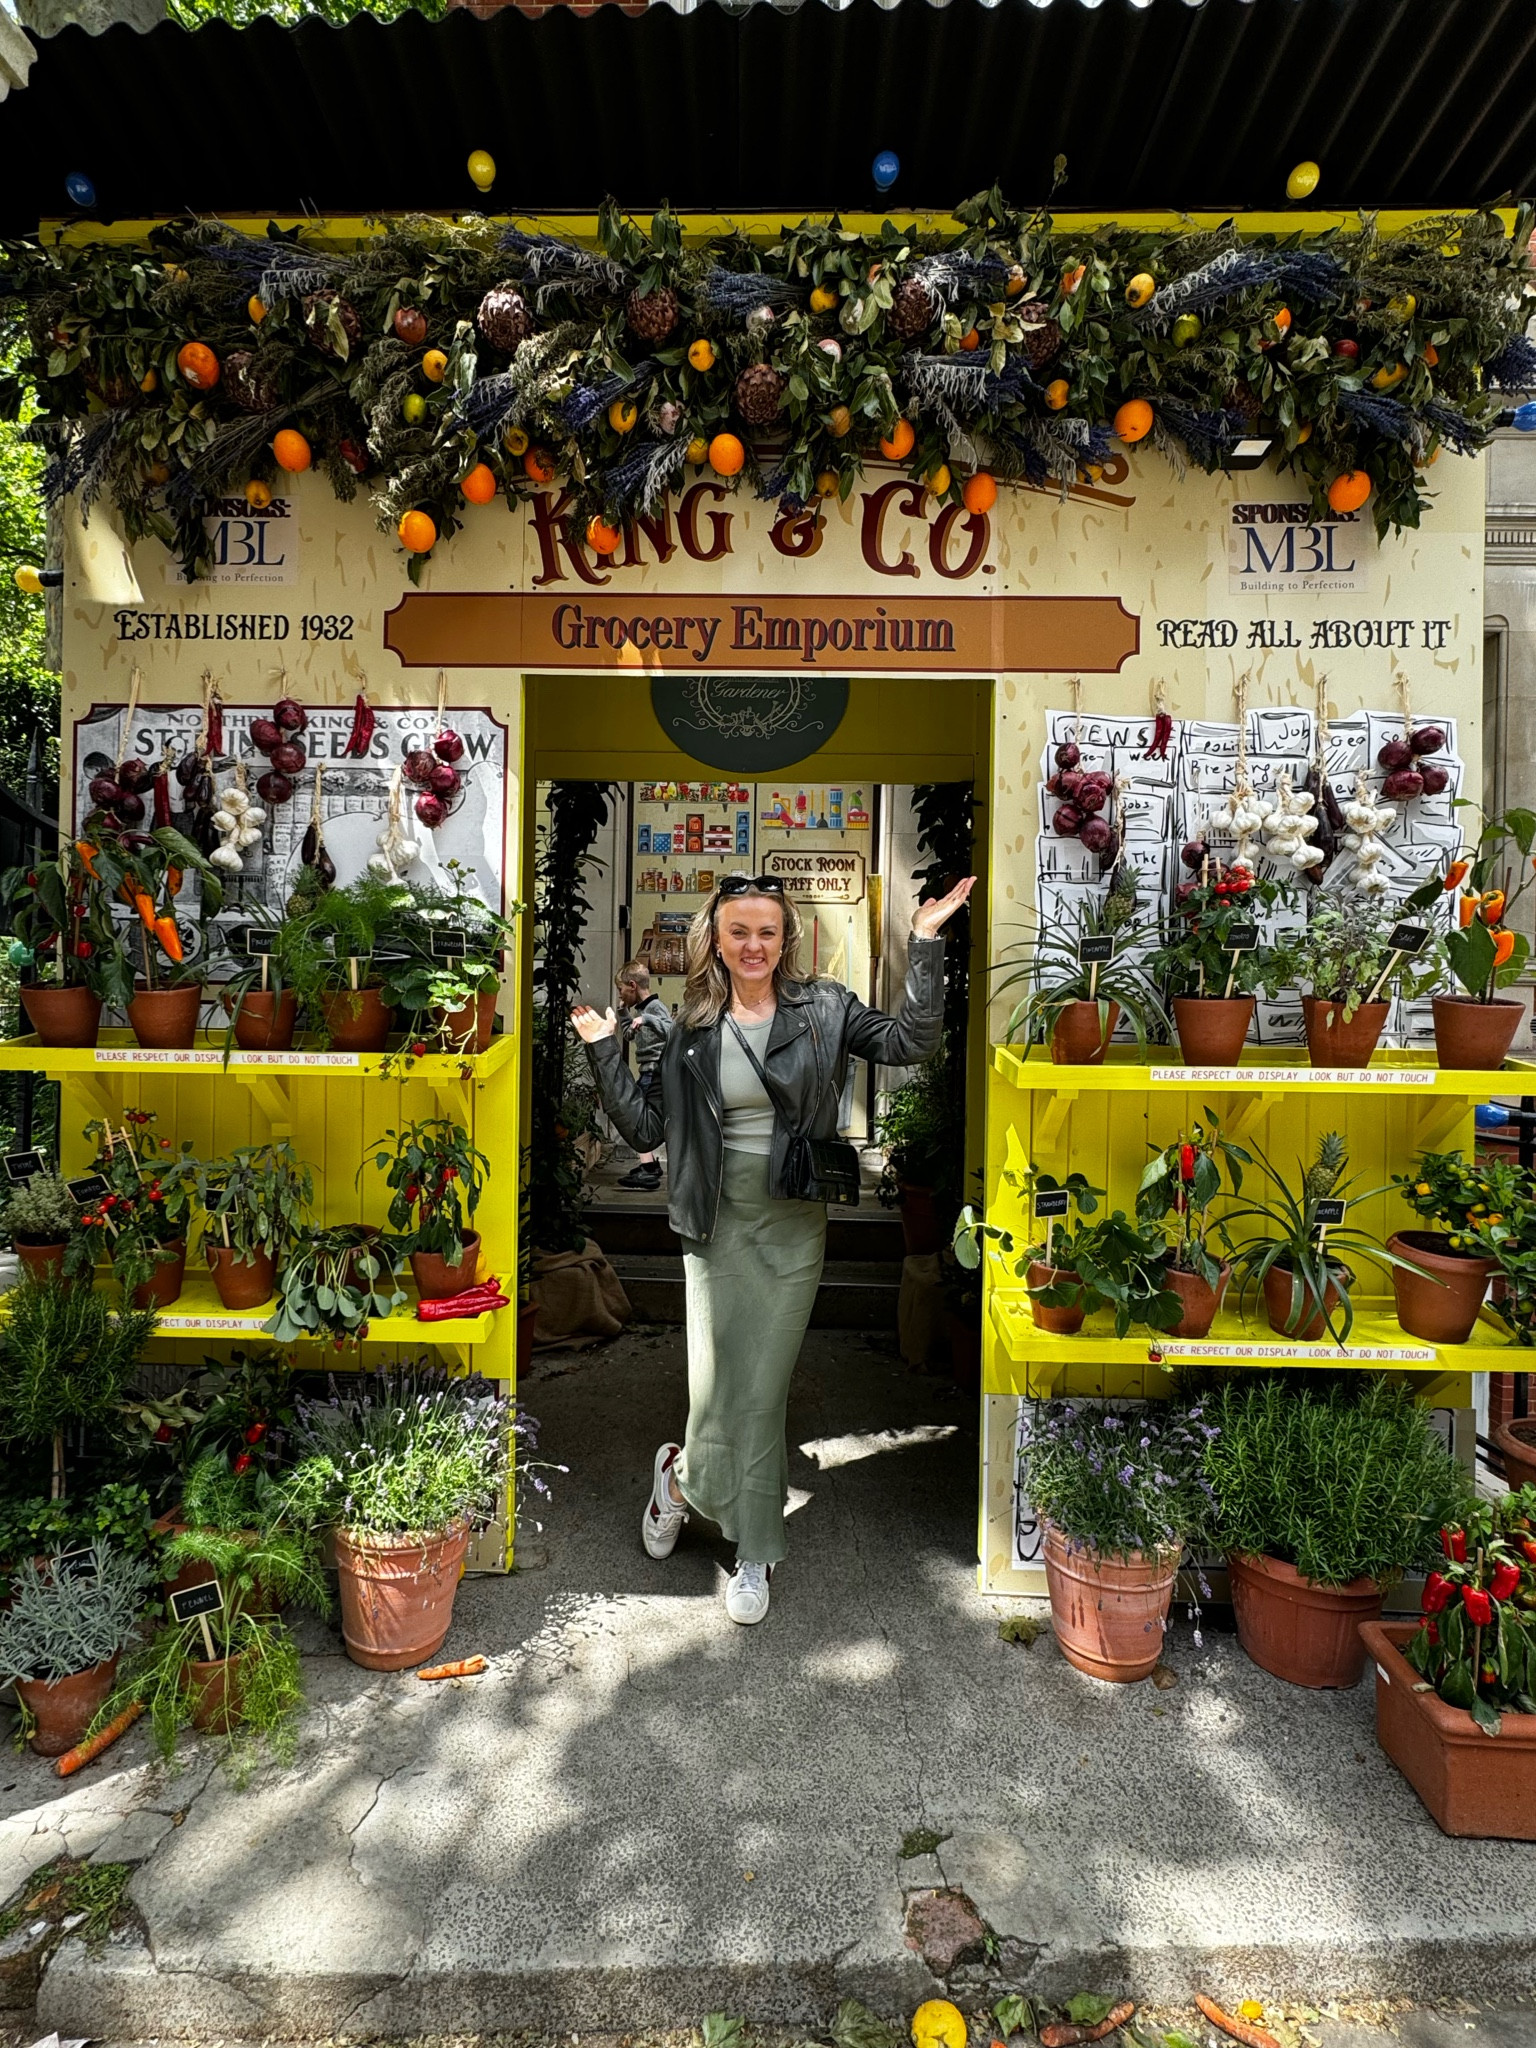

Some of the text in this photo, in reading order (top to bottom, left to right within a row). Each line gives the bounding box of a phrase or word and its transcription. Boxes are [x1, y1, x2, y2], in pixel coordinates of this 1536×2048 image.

[527, 482, 736, 586] KNG
[1239, 525, 1356, 573] MBL
[221, 573, 231, 582] to
[234, 572, 284, 582] Perfection
[1240, 580, 1355, 592] Building to Perfection
[113, 609, 354, 642] ESTABLISHED 1932
[551, 603, 956, 663] Grocery Emporium
[1156, 619, 1452, 651] READ ALL ABOUT IT
[710, 680, 790, 699] Gardener
[1063, 724, 1150, 748] NEWS
[771, 856, 856, 873] STOCK ROOM
[781, 877, 852, 891] TAFF ONLY
[95, 1051, 128, 1061] PLEASE
[132, 1052, 169, 1062] RESPECT
[174, 1053, 190, 1062] OUR
[242, 1054, 263, 1064] LOOK
[268, 1054, 283, 1064] BUT
[288, 1055, 300, 1064] DO
[304, 1055, 320, 1065] NOT
[326, 1055, 353, 1065] TOUCH
[1152, 1070, 1429, 1083] PLEASE RESPECT OUR DISPLAY LOOK BUT DO NOT TOUCH
[185, 1318, 201, 1328] OUR
[206, 1319, 243, 1329] DISPLAY
[1152, 1344, 1186, 1354] PEASE
[1190, 1345, 1231, 1355] RESPECT
[1235, 1346, 1253, 1356] OUR
[1258, 1347, 1298, 1357] DISPLAY
[1308, 1348, 1332, 1358] LOOK
[1359, 1349, 1372, 1359] DO
[1376, 1349, 1395, 1360] NOT
[1400, 1350, 1429, 1360] TOUCH
